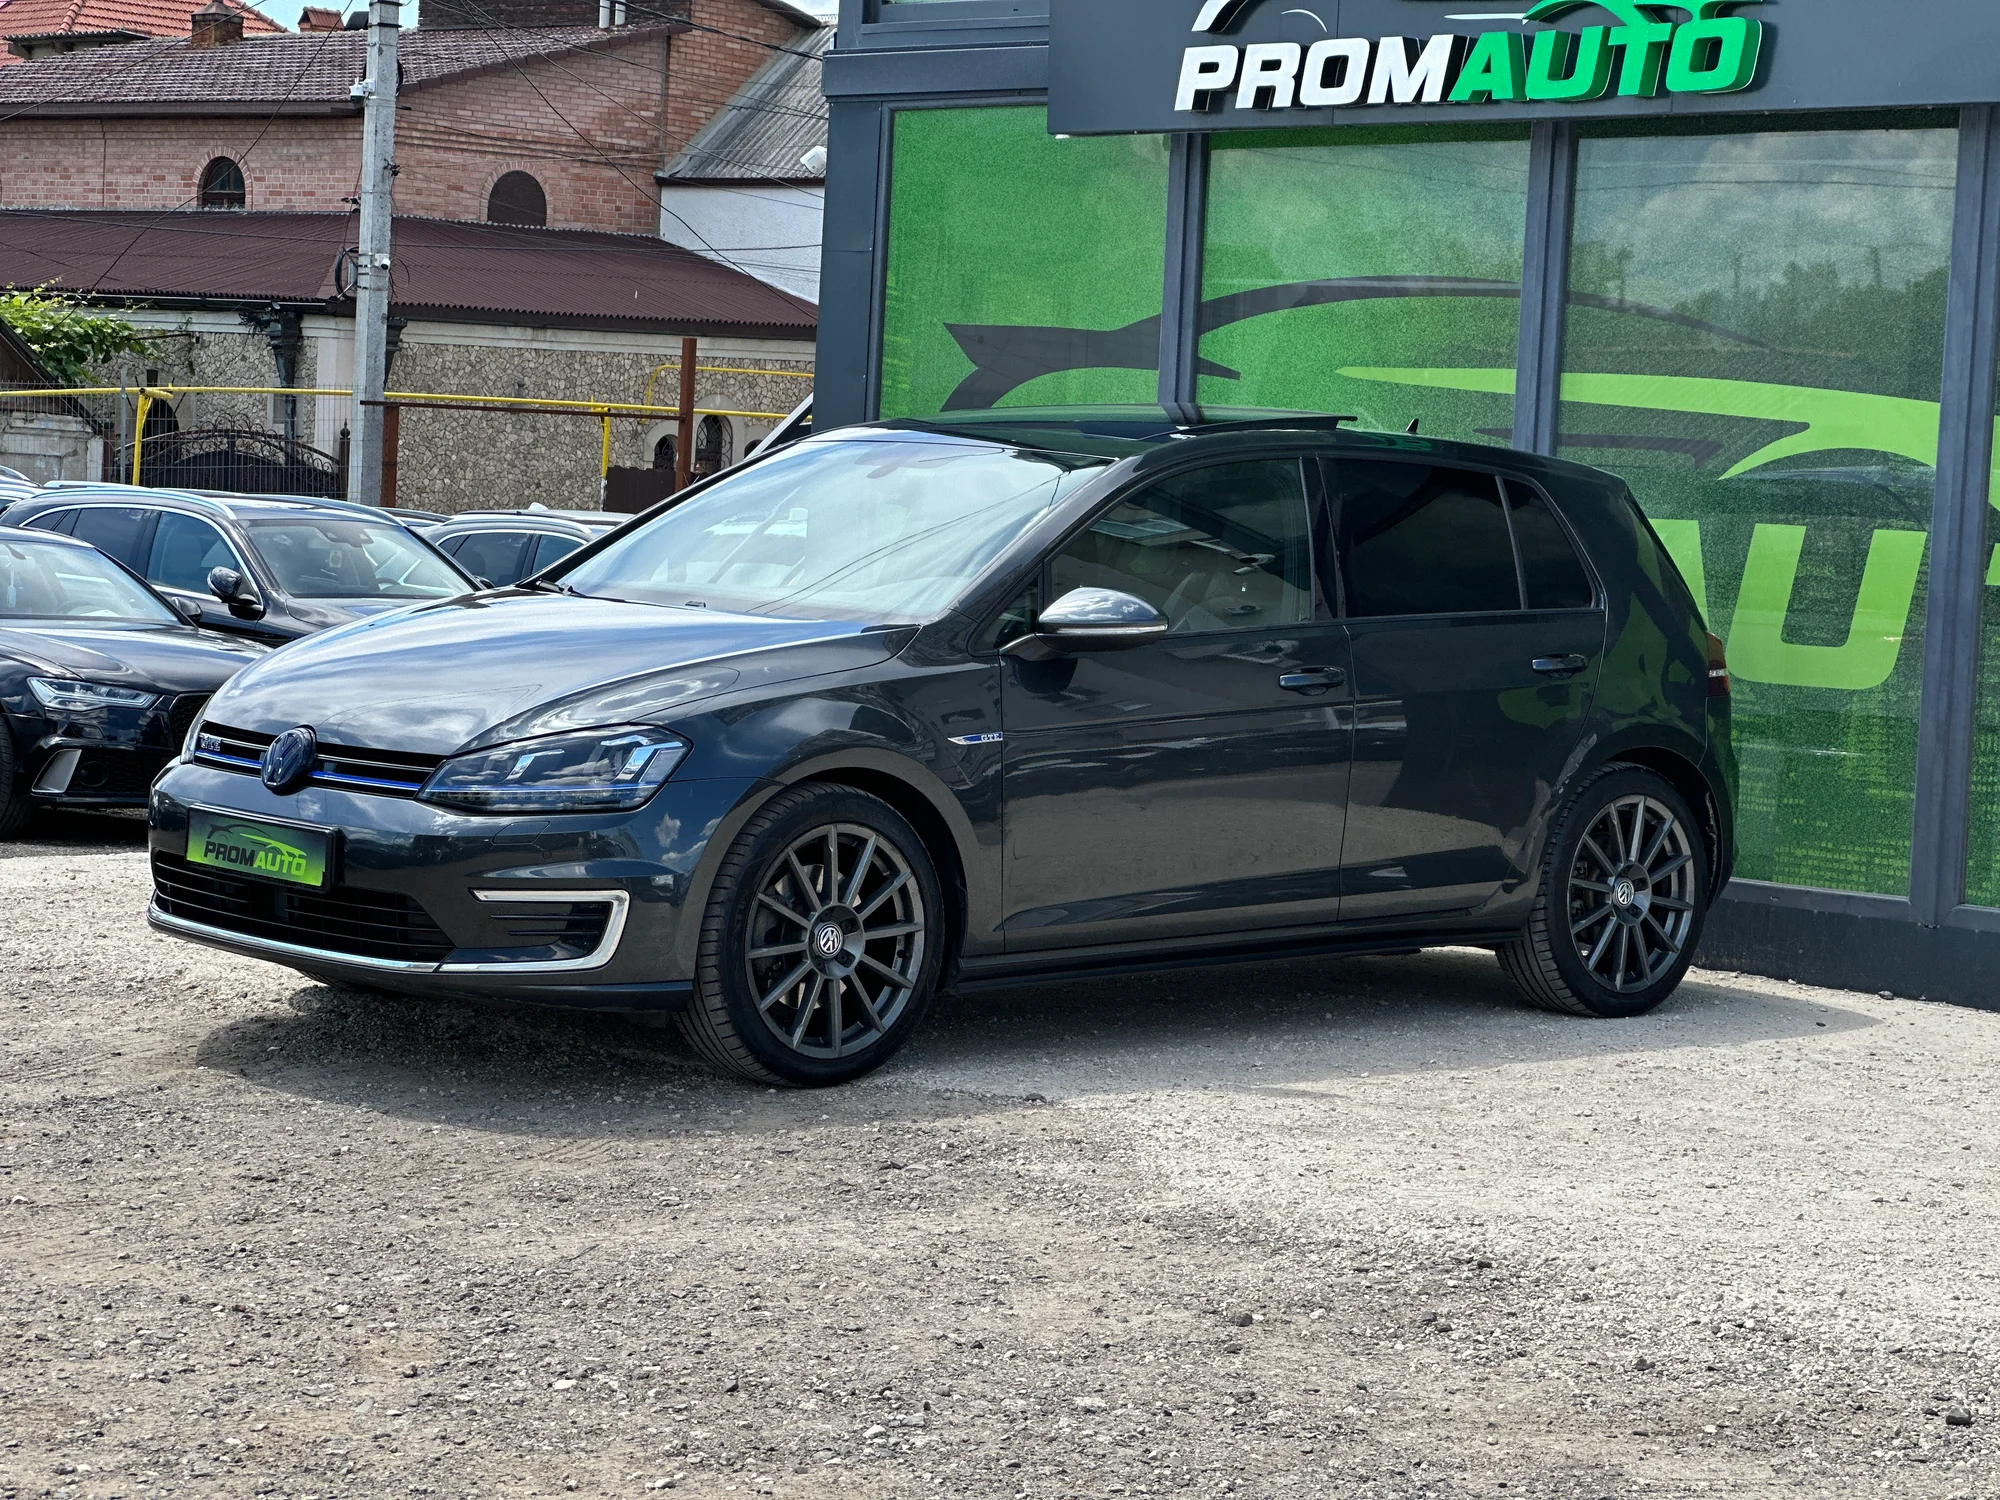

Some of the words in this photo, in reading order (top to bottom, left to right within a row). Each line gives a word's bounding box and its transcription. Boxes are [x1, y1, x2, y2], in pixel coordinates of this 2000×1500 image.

[1174, 17, 1760, 111] PROMAUTO
[981, 733, 1000, 741] GTE
[203, 840, 307, 877] PROMAUTO
